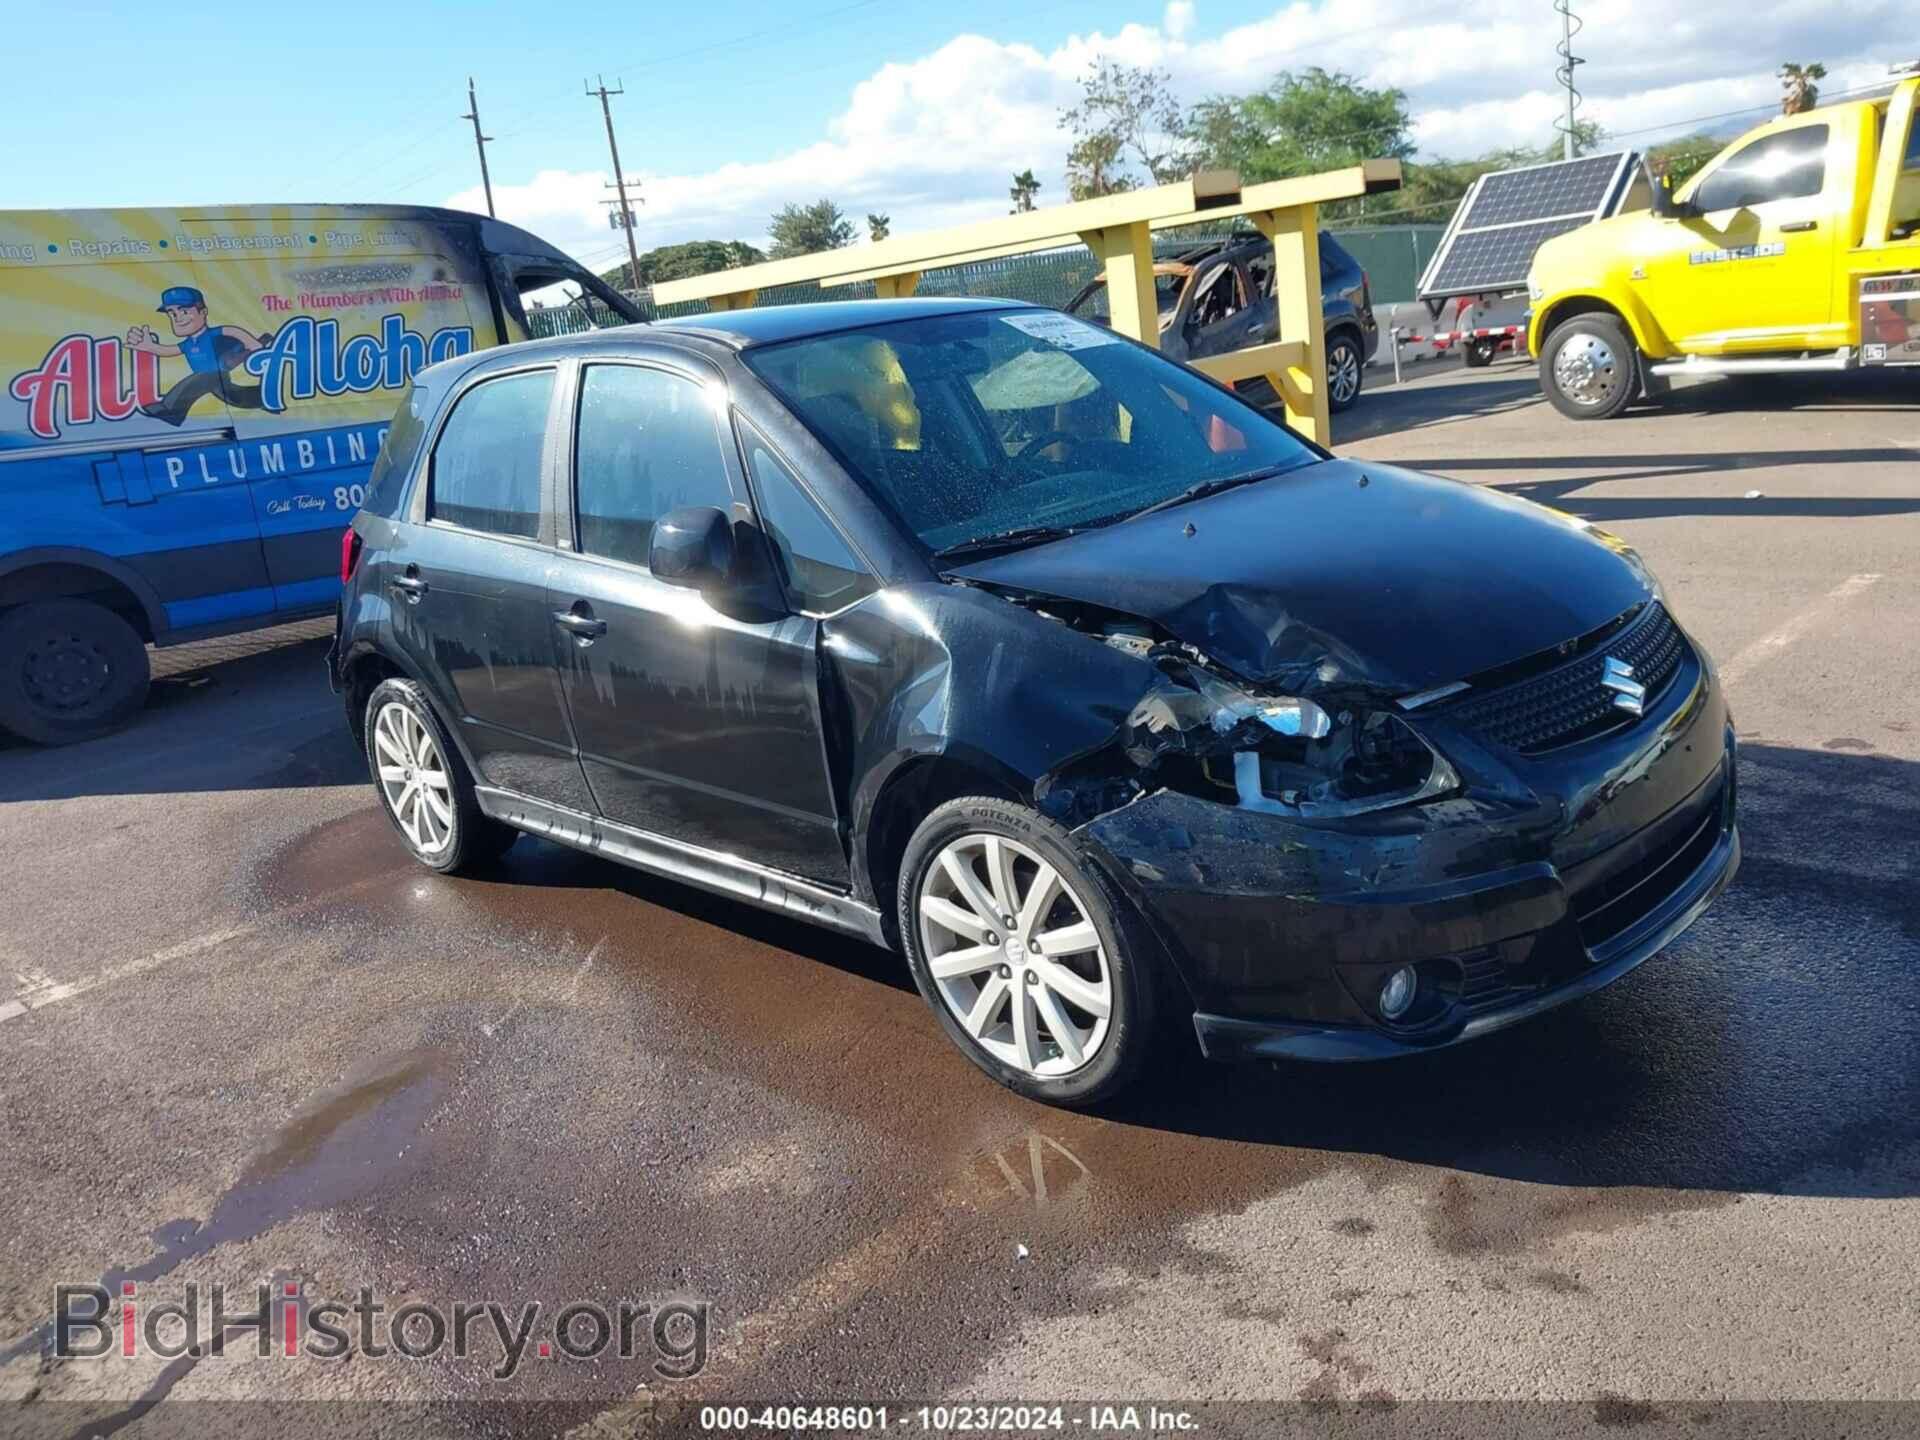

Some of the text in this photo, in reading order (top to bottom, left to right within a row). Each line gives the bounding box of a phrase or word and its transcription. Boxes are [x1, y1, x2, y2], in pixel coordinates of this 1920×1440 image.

[68, 237, 153, 258] Repairs
[175, 231, 303, 254] Replacement
[323, 230, 363, 249] Pipe
[262, 294, 293, 312] The
[298, 288, 377, 310] Plumbers
[9, 313, 474, 440] All Aloha
[266, 494, 326, 515] Call Today
[333, 483, 370, 511] 80
[971, 807, 1033, 833] POTENZA
